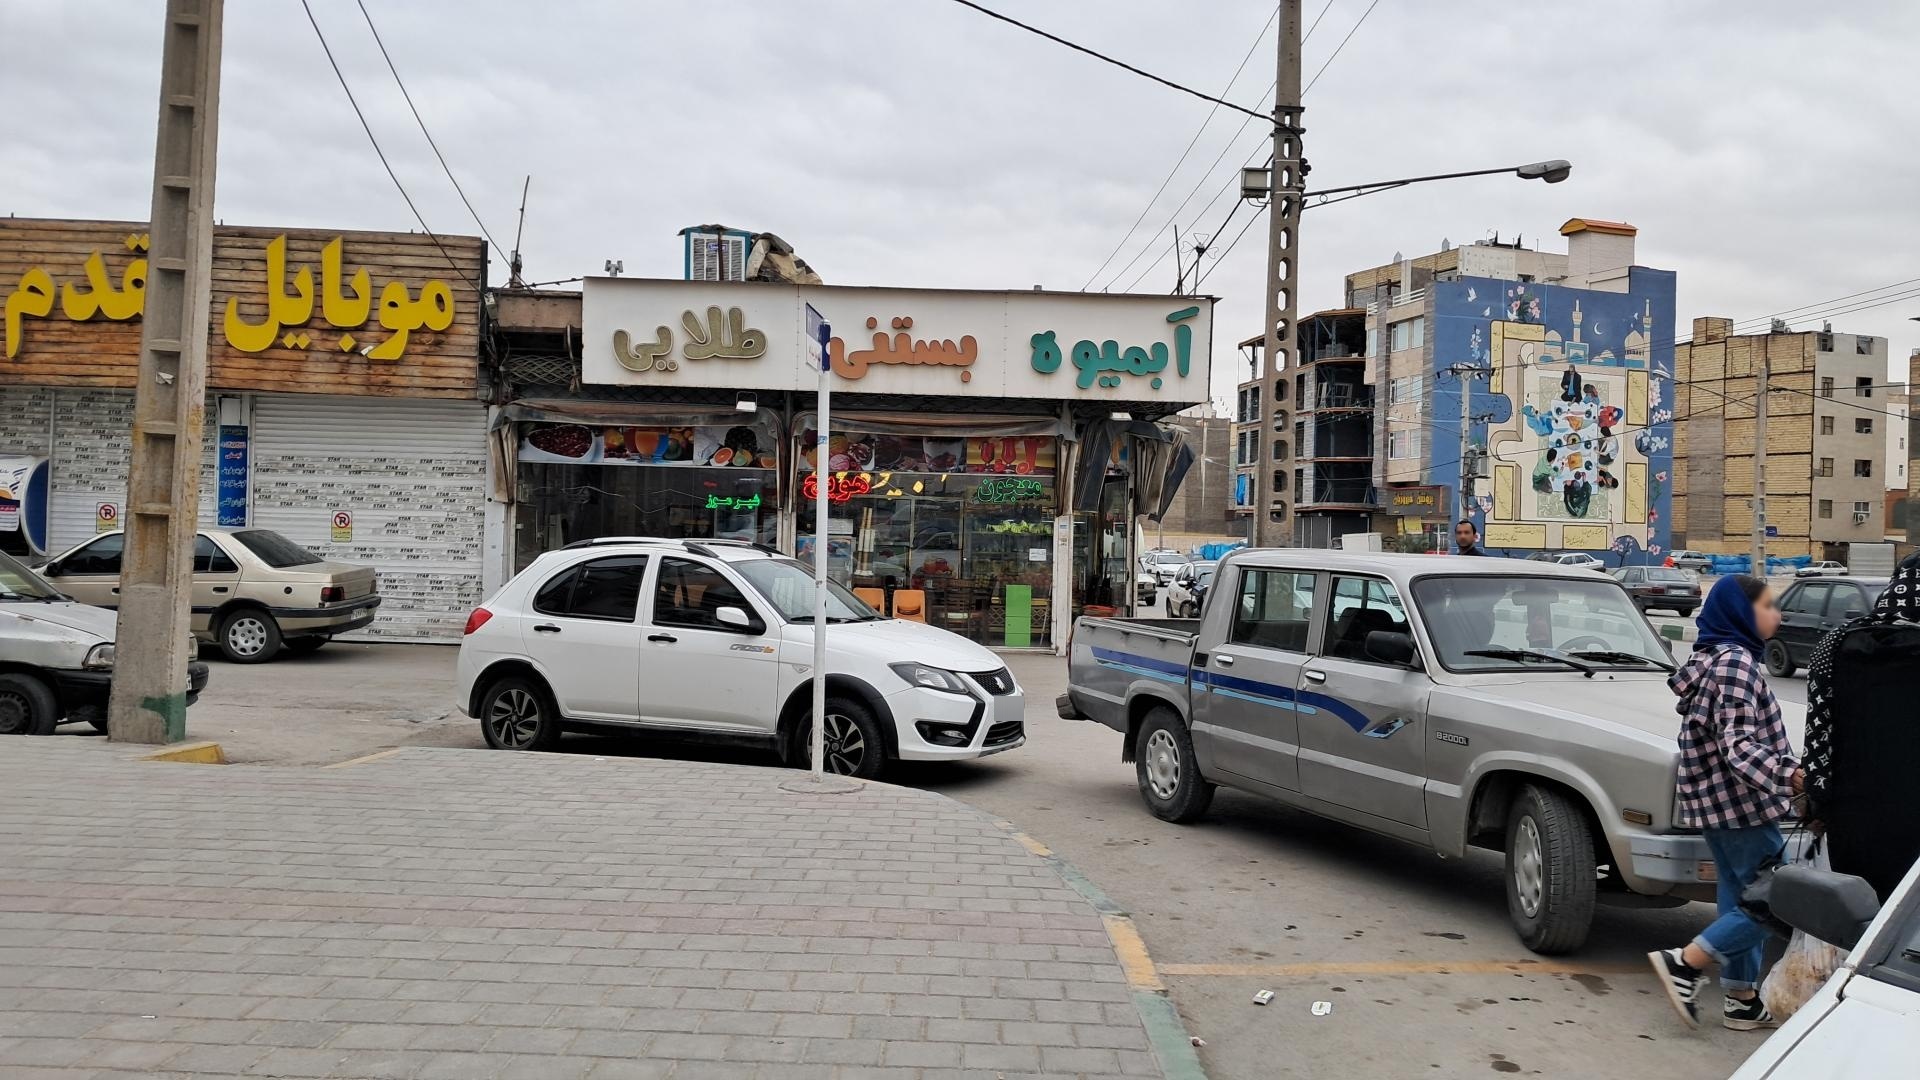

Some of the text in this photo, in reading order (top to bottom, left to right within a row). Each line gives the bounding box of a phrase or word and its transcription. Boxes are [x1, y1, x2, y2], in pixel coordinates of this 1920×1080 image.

[4, 232, 455, 360] موبایل قدم
[613, 305, 1200, 390] آبمیوه بستنی طلایی
[705, 494, 733, 509] موز
[978, 478, 1042, 503] معجون
